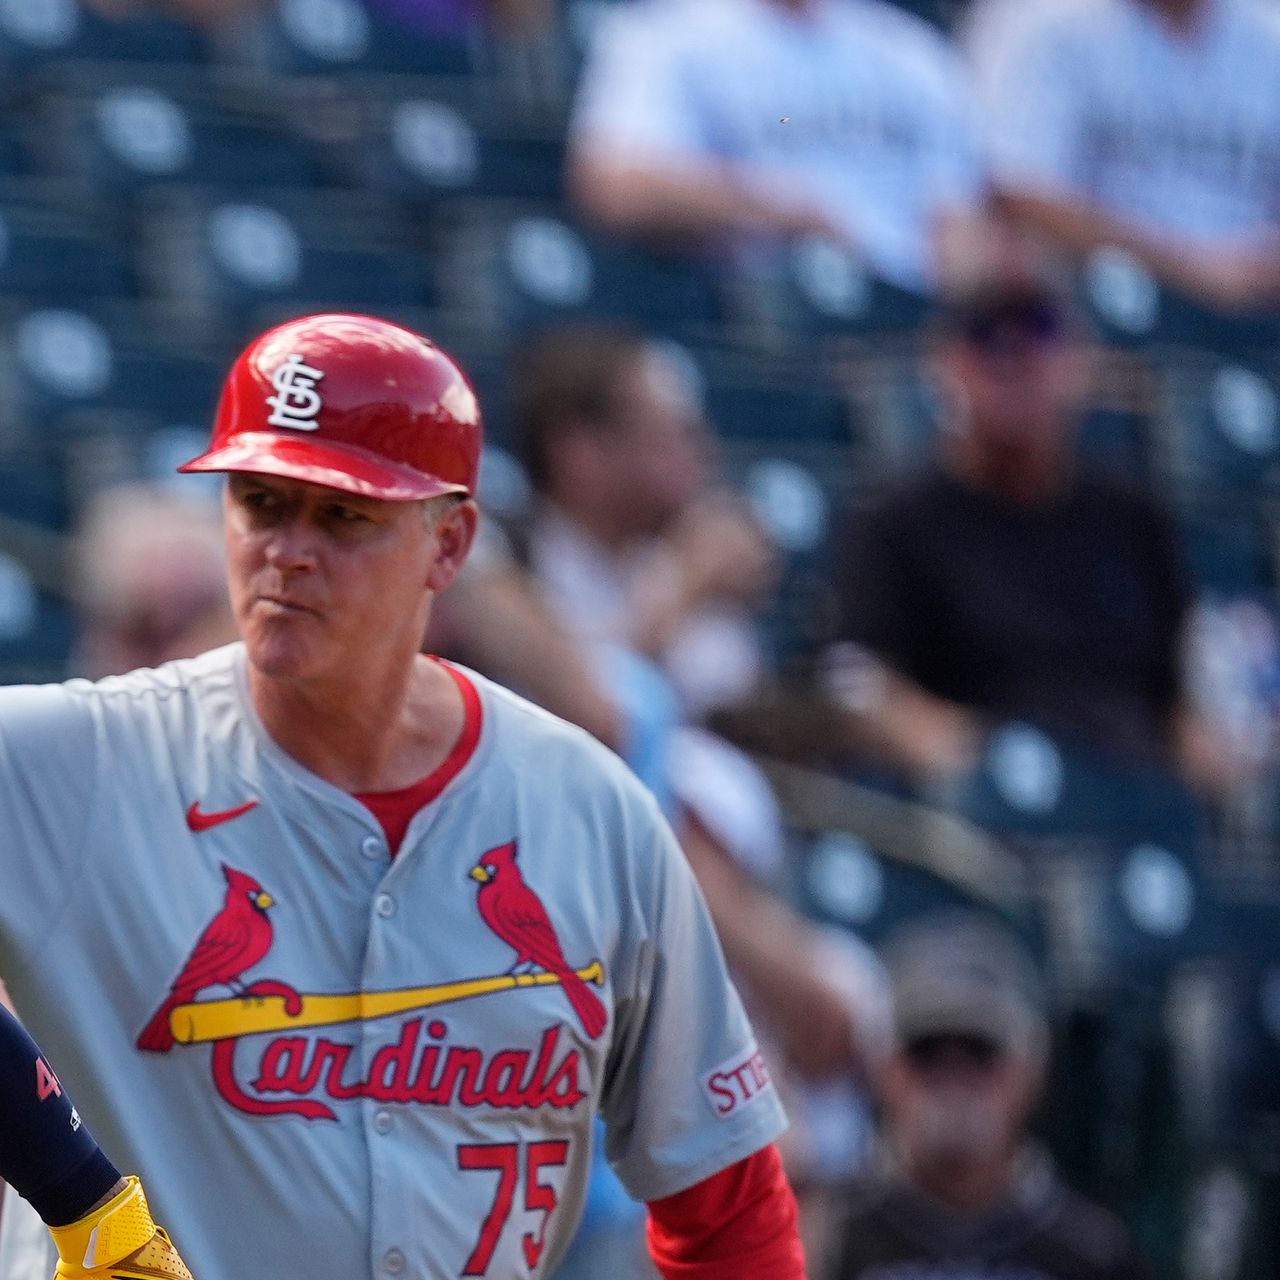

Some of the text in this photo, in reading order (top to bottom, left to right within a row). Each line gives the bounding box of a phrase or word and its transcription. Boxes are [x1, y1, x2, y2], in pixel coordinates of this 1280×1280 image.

[36, 1056, 62, 1101] 4
[212, 980, 587, 1122] Cardinals
[457, 1140, 570, 1277] 75
